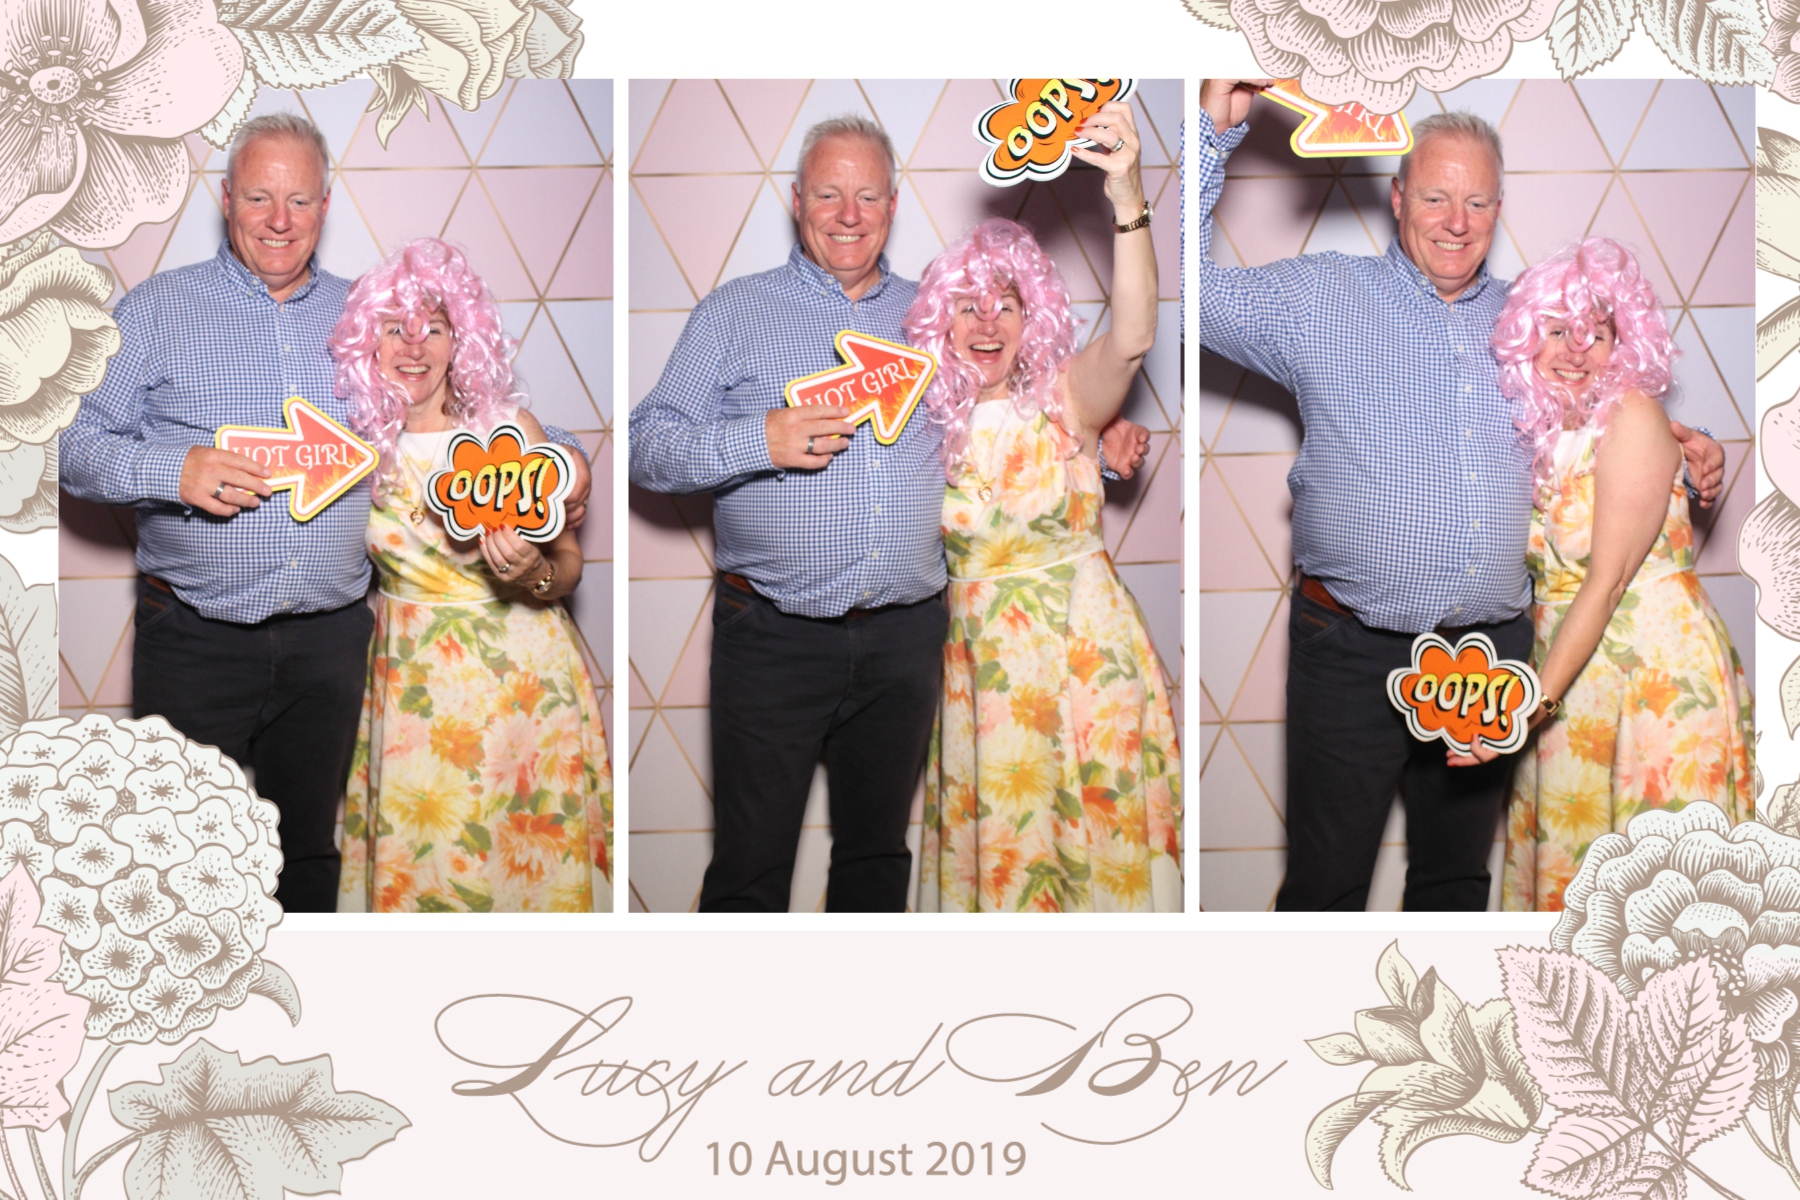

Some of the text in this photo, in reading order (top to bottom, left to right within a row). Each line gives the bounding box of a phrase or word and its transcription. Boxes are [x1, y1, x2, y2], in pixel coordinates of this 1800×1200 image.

[861, 358, 918, 395] GIRL
[295, 443, 355, 470] GIRL
[447, 457, 555, 520] OOPS!
[1411, 672, 1521, 732] OOPS!
